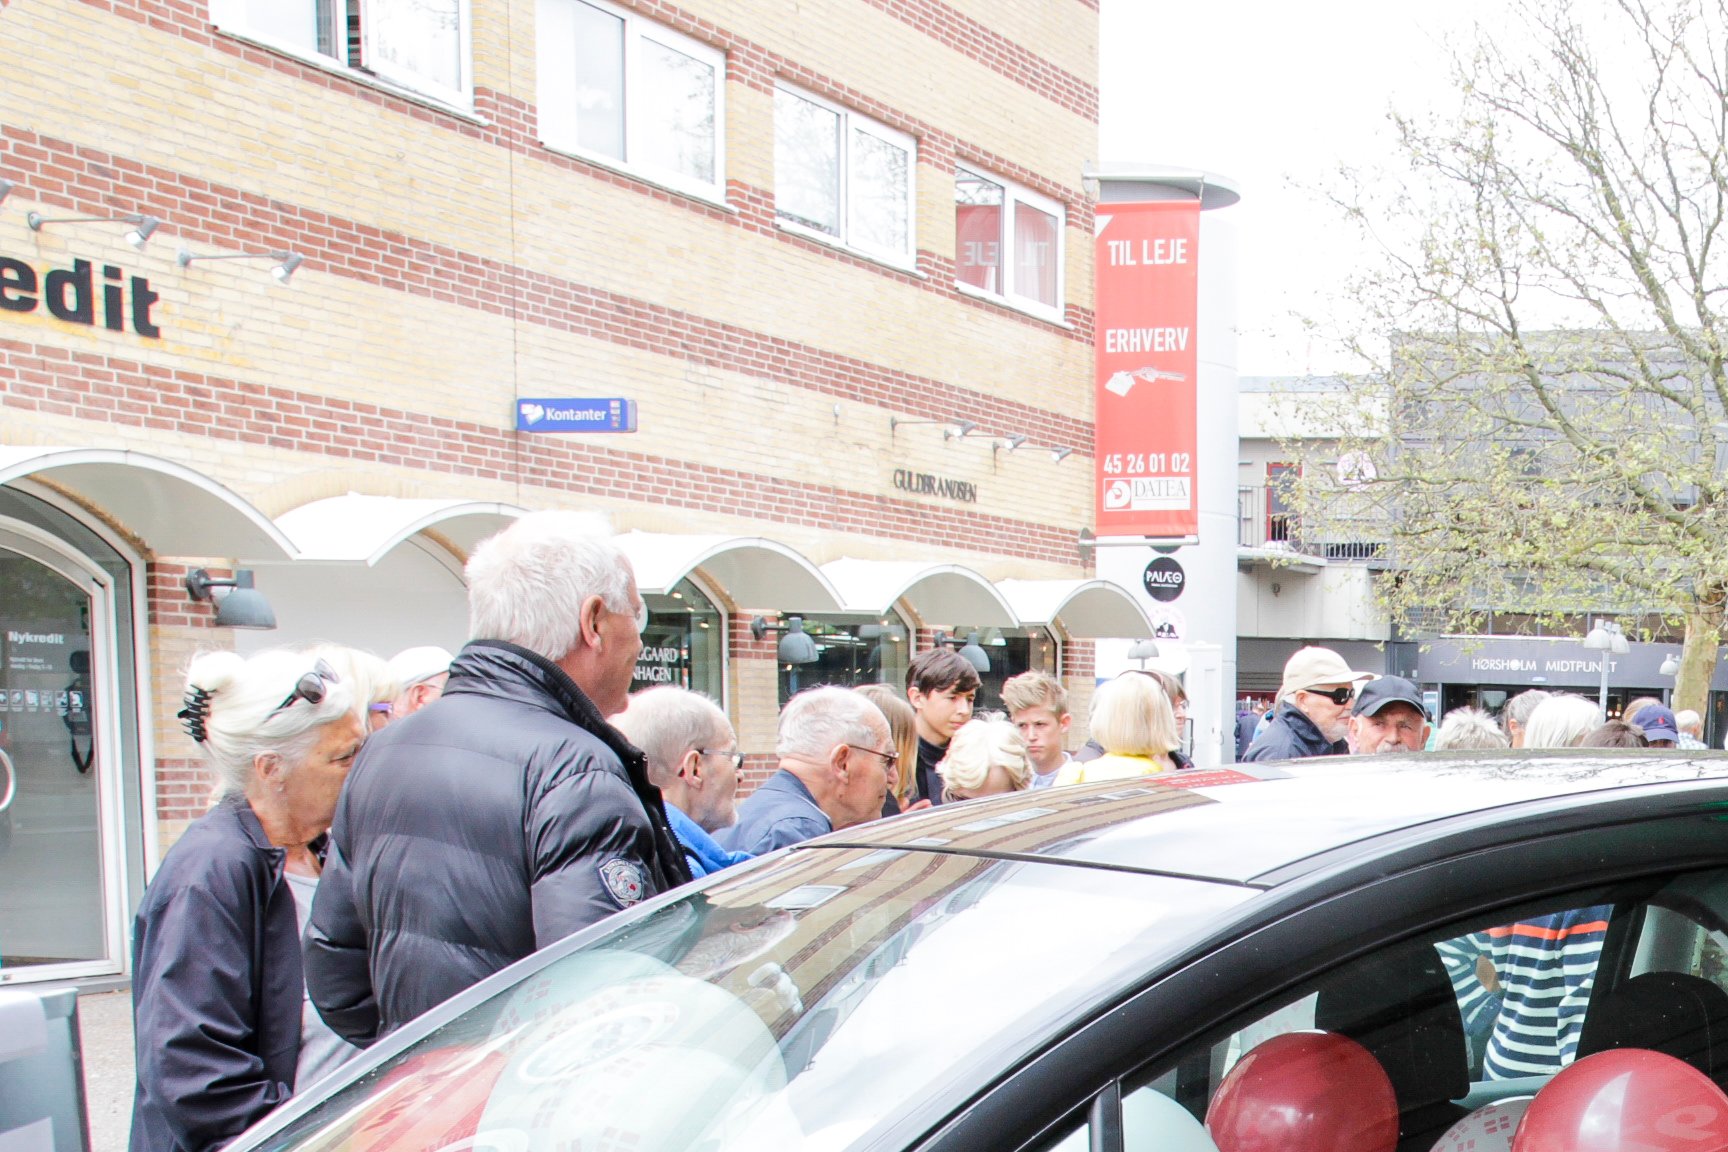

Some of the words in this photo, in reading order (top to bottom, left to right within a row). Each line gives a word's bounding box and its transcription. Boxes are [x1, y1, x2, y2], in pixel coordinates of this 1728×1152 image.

[1107, 240, 1137, 266] TIL
[1143, 239, 1187, 265] LEJE
[0, 257, 160, 340] edit
[1106, 327, 1189, 353] ERHVERV
[546, 407, 607, 421] Kontanter
[1104, 454, 1122, 474] 45
[1127, 453, 1145, 473] 26
[1149, 453, 1166, 473] 01
[1171, 453, 1190, 473] 02
[1134, 480, 1187, 497] DATEA
[1146, 571, 1183, 583] PALÆO
[7, 631, 64, 644] Nykredit
[1546, 660, 1617, 673] MIDTPUNT
